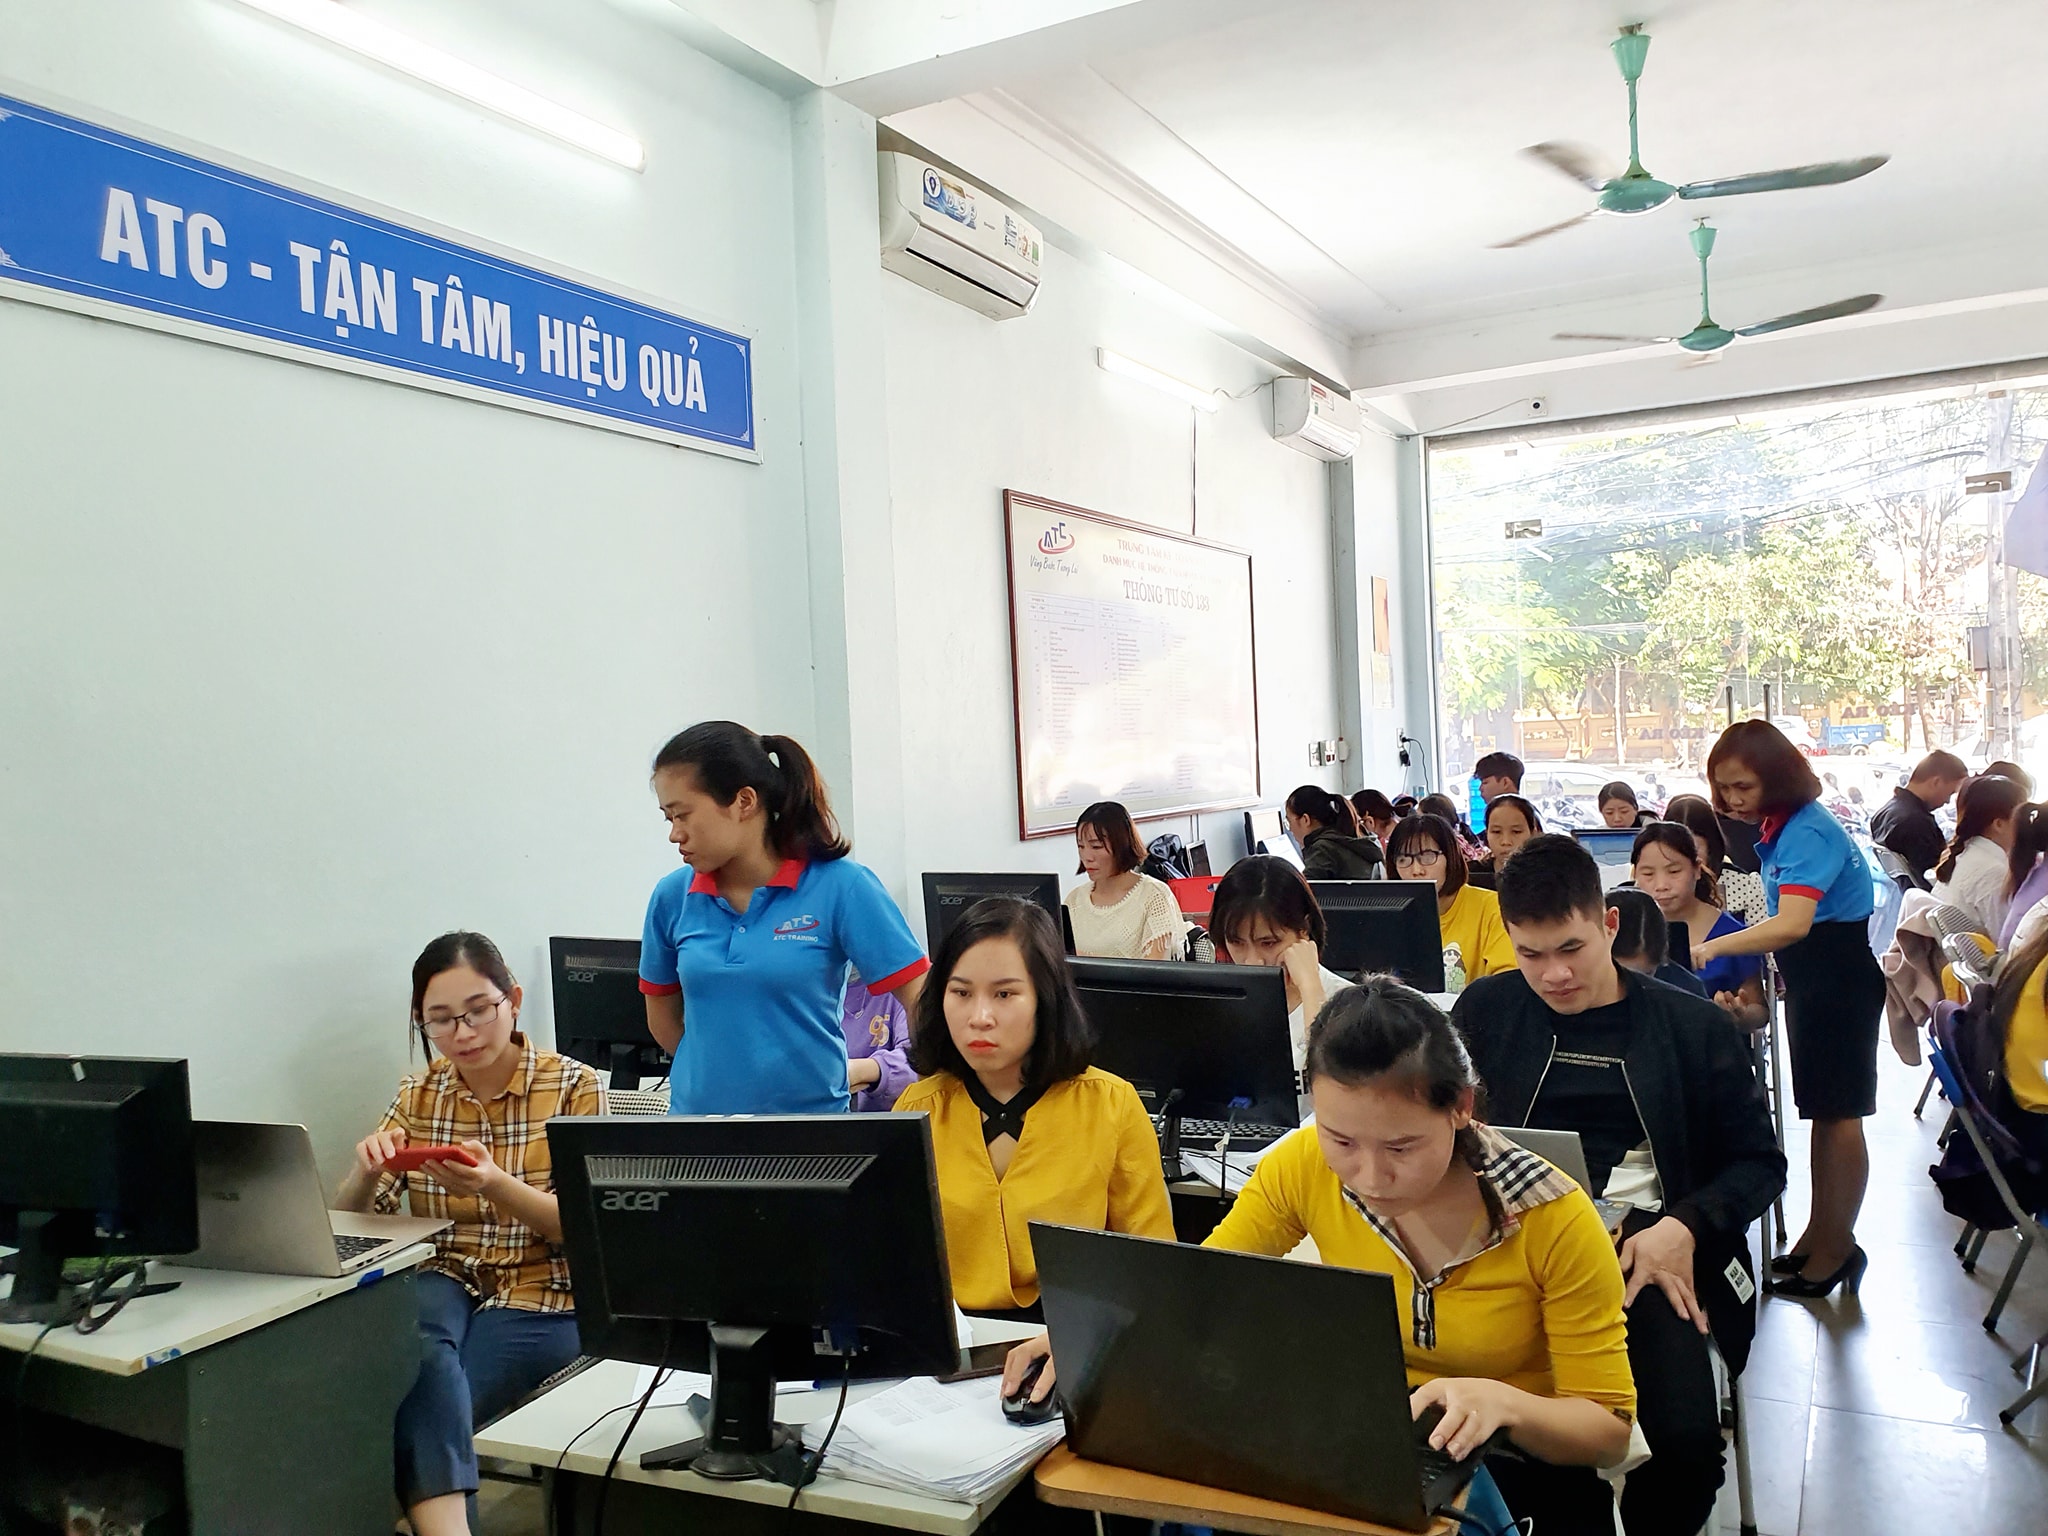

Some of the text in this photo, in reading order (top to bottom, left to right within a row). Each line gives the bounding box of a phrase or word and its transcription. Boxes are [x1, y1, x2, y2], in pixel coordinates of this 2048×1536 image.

[100, 186, 229, 290] ATC
[290, 238, 398, 338] TẬN
[412, 273, 526, 375] TÂM,
[538, 315, 628, 398] HIỆU
[638, 335, 708, 414] QUẢ
[1044, 521, 1067, 548] ATC
[940, 895, 965, 905] acer
[780, 914, 813, 931] ATC
[787, 934, 819, 943] TRAINING
[567, 970, 598, 983] acer
[601, 1190, 670, 1212] acer
